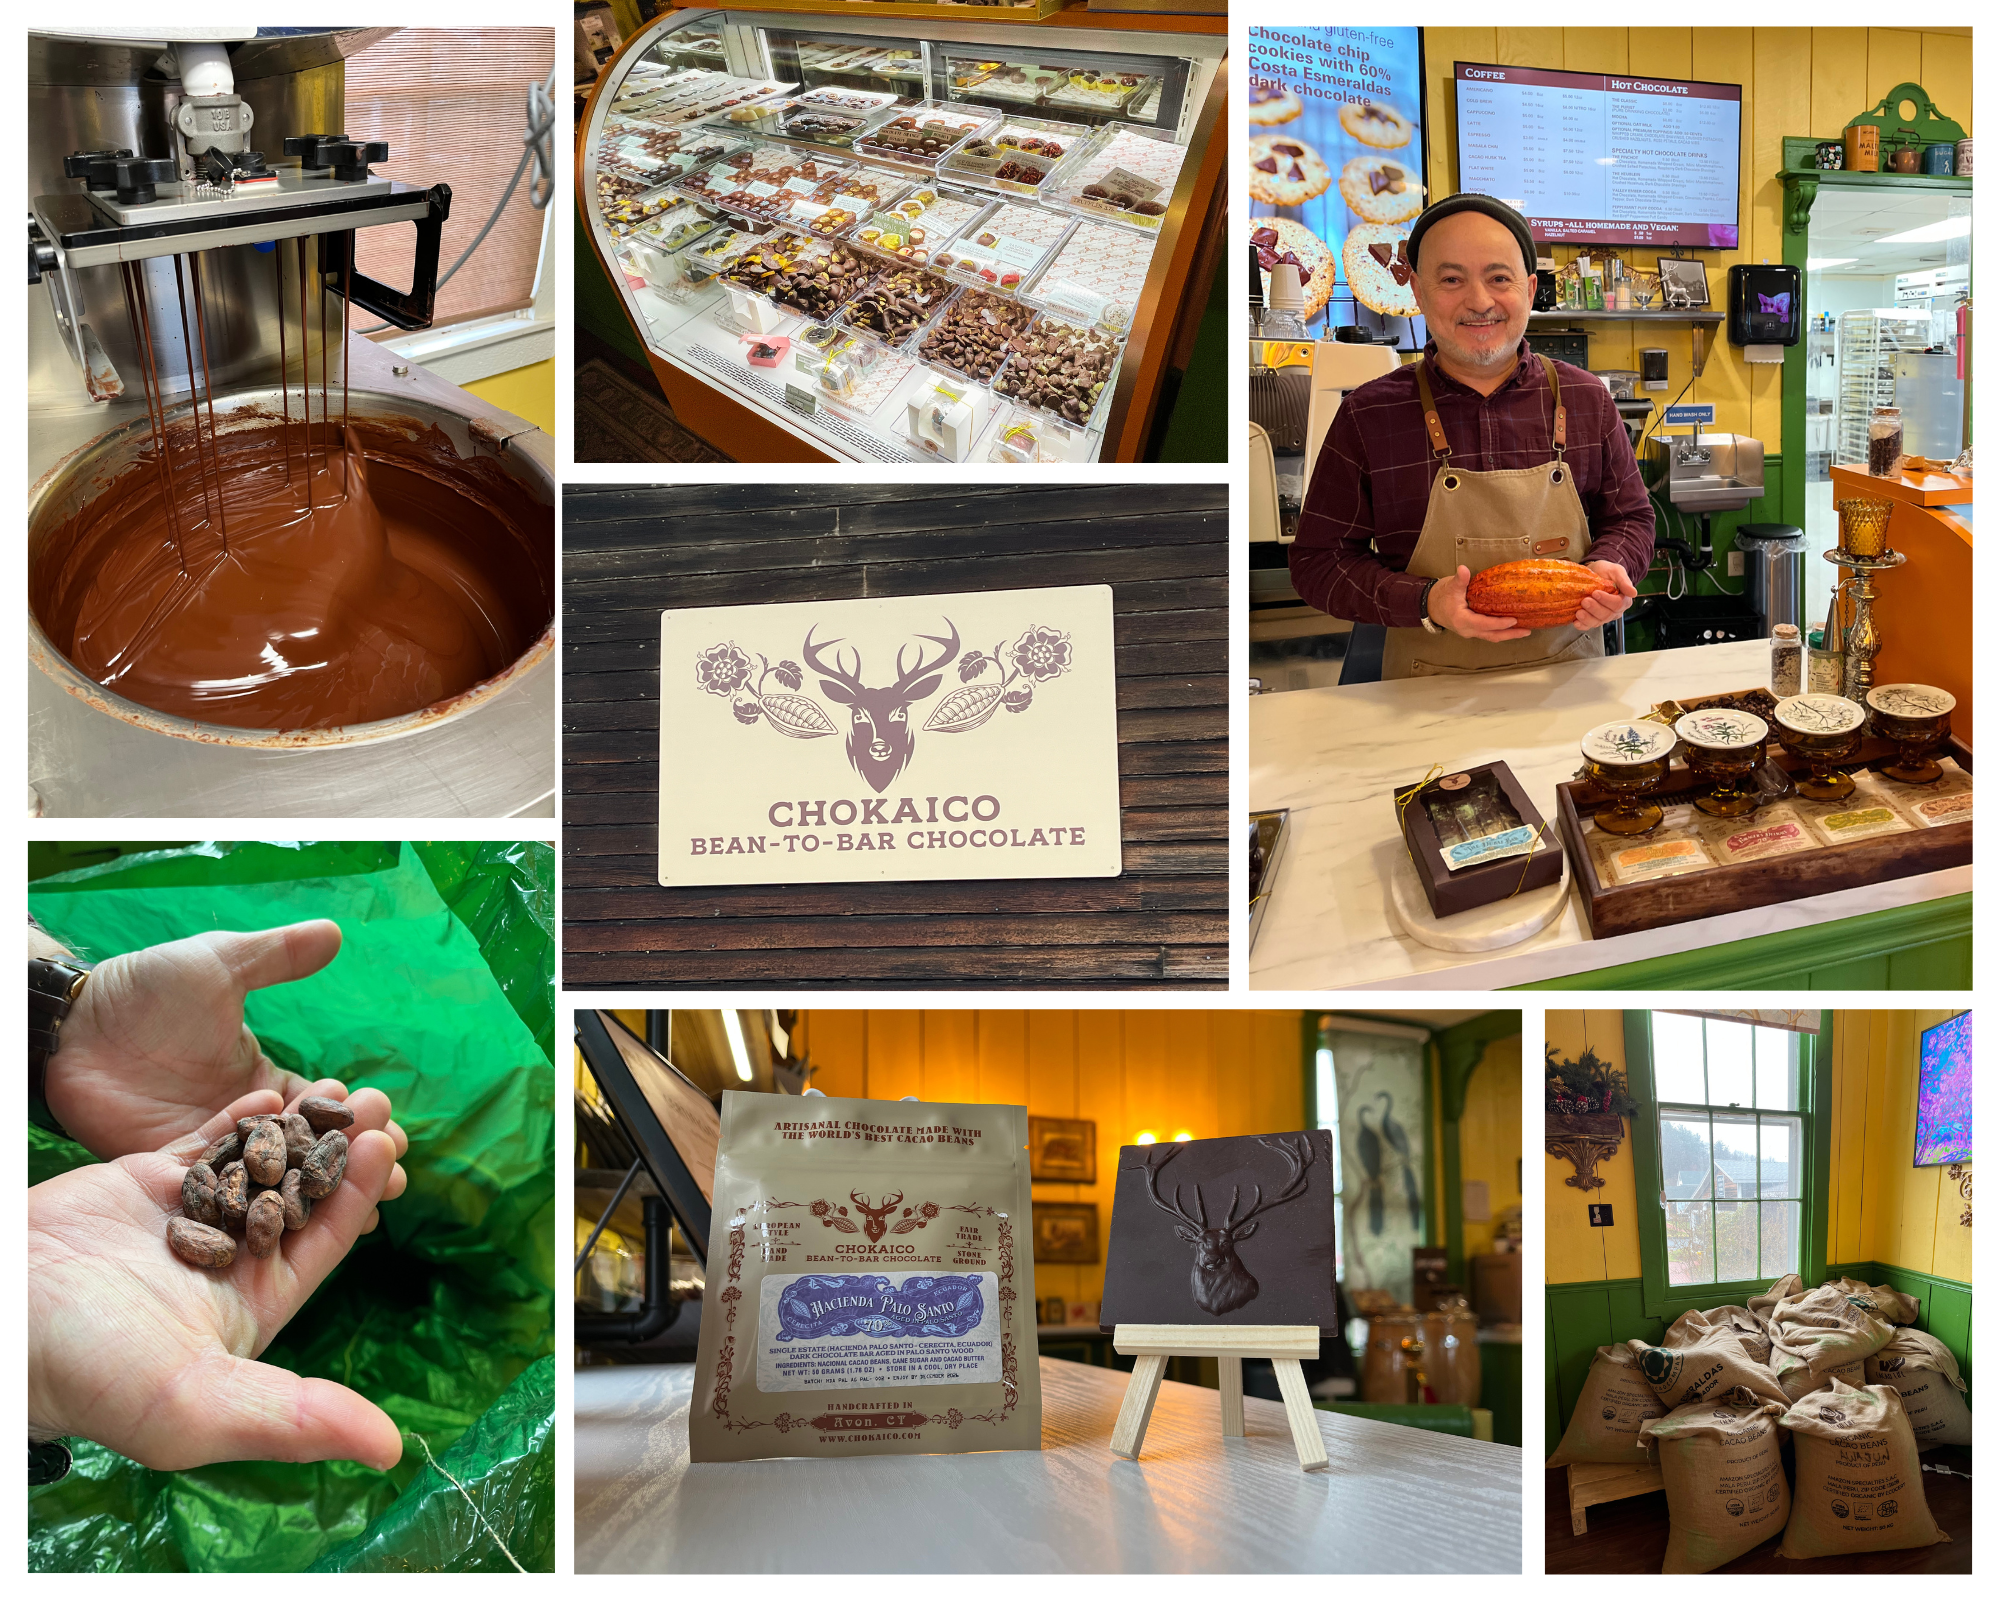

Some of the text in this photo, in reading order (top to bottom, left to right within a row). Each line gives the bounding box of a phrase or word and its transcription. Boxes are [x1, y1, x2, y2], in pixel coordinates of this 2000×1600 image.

[1249, 26, 1370, 62] Chocolate chip
[1325, 26, 1394, 48] gluten-free
[1249, 43, 1391, 81] cookies with 60%
[1249, 57, 1391, 96] Costa Esmeraldas
[1249, 74, 1371, 107] dark chocolate
[768, 794, 1000, 827] CHOKAICO
[690, 826, 1086, 856] BEAN-TO-BAR CHOCOLATE
[774, 1121, 982, 1138] ARTISANAL CHOCOLATE MADE WITH
[782, 1130, 975, 1146] THE WORLD'S BEST CACAO BEANS
[956, 1233, 983, 1241] TRADE
[835, 1245, 915, 1253] CHOKAICO
[934, 1285, 968, 1296] ECUADOR
[810, 1295, 954, 1321] HACIENDA PALO SANTO
[787, 1316, 822, 1328] CERECITA
[1901, 1384, 1929, 1397] BEANS
[827, 1402, 900, 1411] HANDCRAFTED
[886, 1415, 906, 1425] CT
[819, 1432, 921, 1443] WWW.CHOKAICO.COM
[1829, 1439, 1888, 1449] CACAO BEANS
